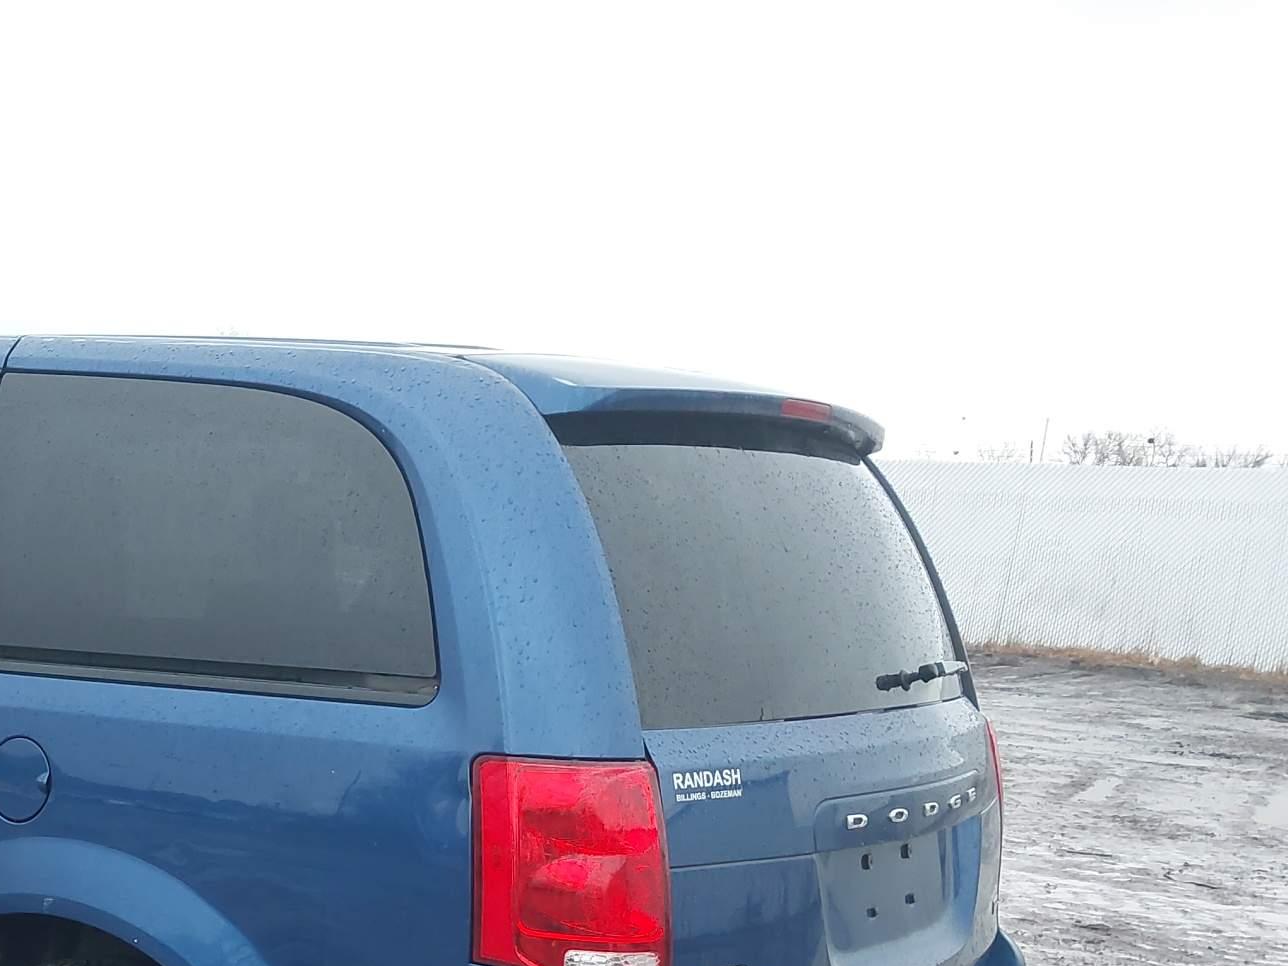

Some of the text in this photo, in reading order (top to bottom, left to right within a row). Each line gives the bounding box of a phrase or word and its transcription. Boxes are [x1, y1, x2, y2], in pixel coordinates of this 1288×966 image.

[673, 768, 741, 790] RANDASH
[676, 789, 742, 802] BILLINGS BOZEMAN
[846, 787, 977, 830] DODGE
